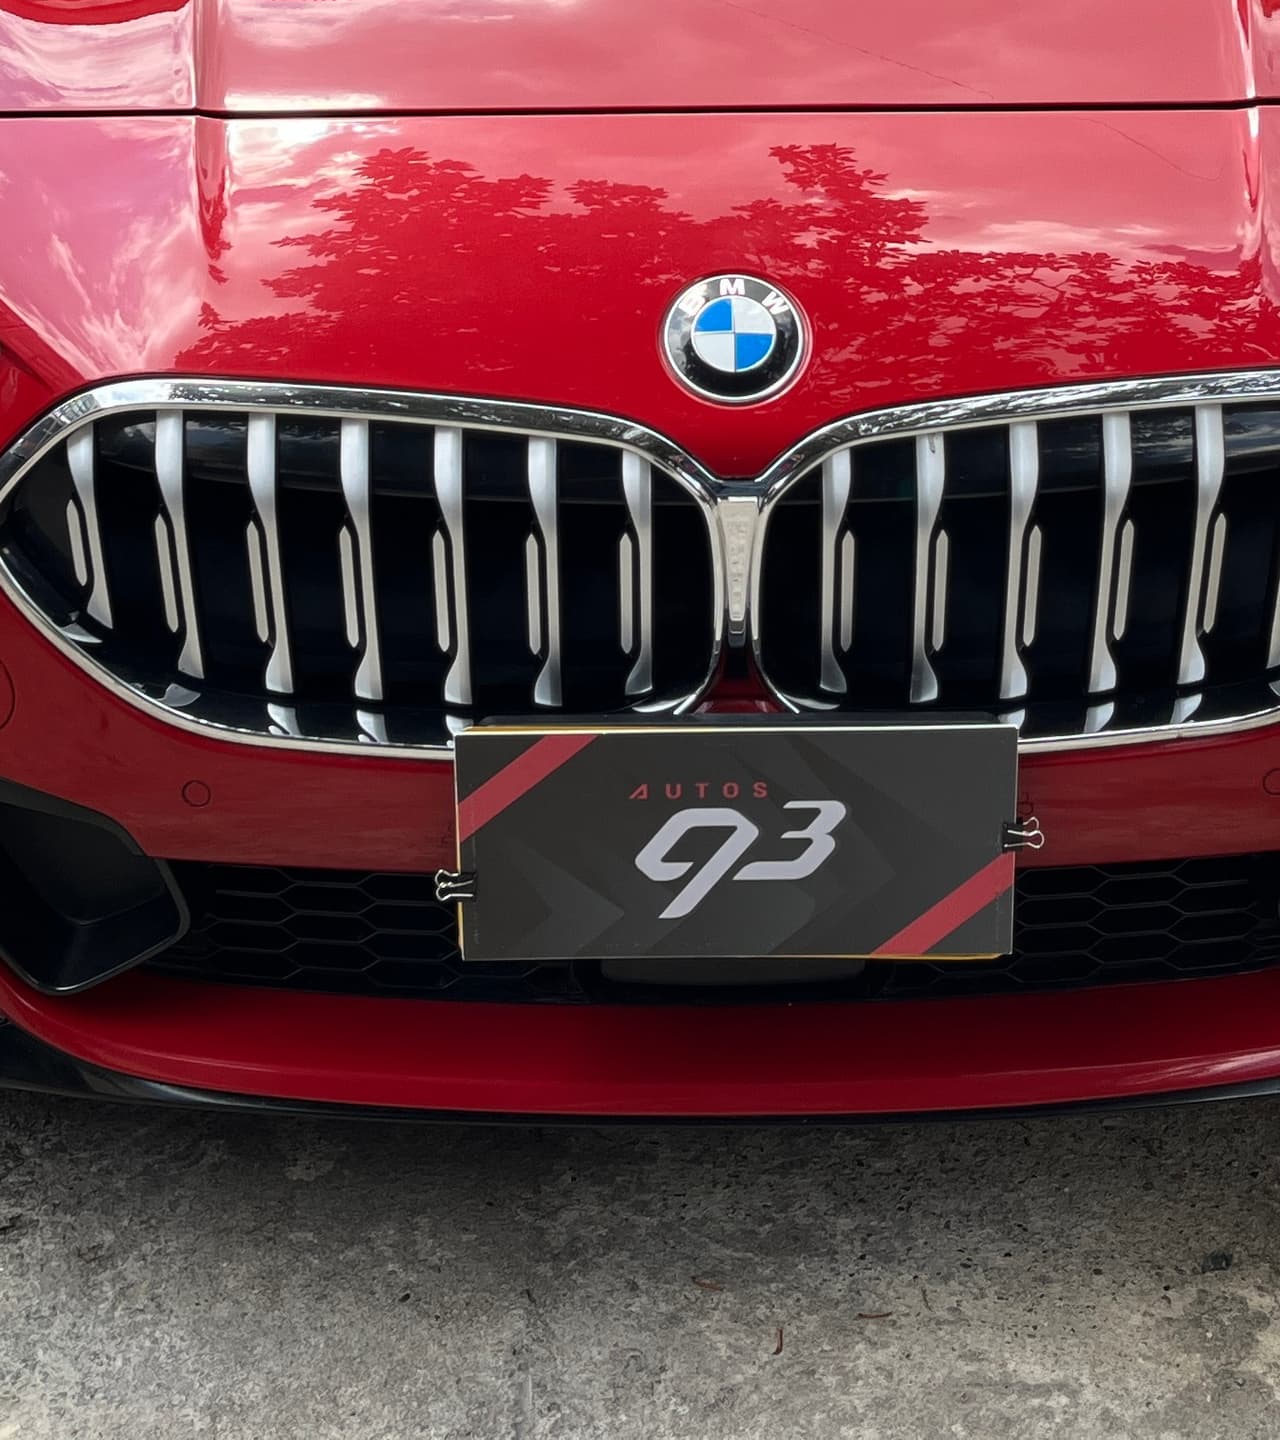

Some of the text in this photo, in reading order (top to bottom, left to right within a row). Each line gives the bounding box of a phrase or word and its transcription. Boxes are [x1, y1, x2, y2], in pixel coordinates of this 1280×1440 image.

[678, 278, 790, 317] BMW
[629, 781, 768, 800] AUTOS
[634, 799, 847, 919] 93
